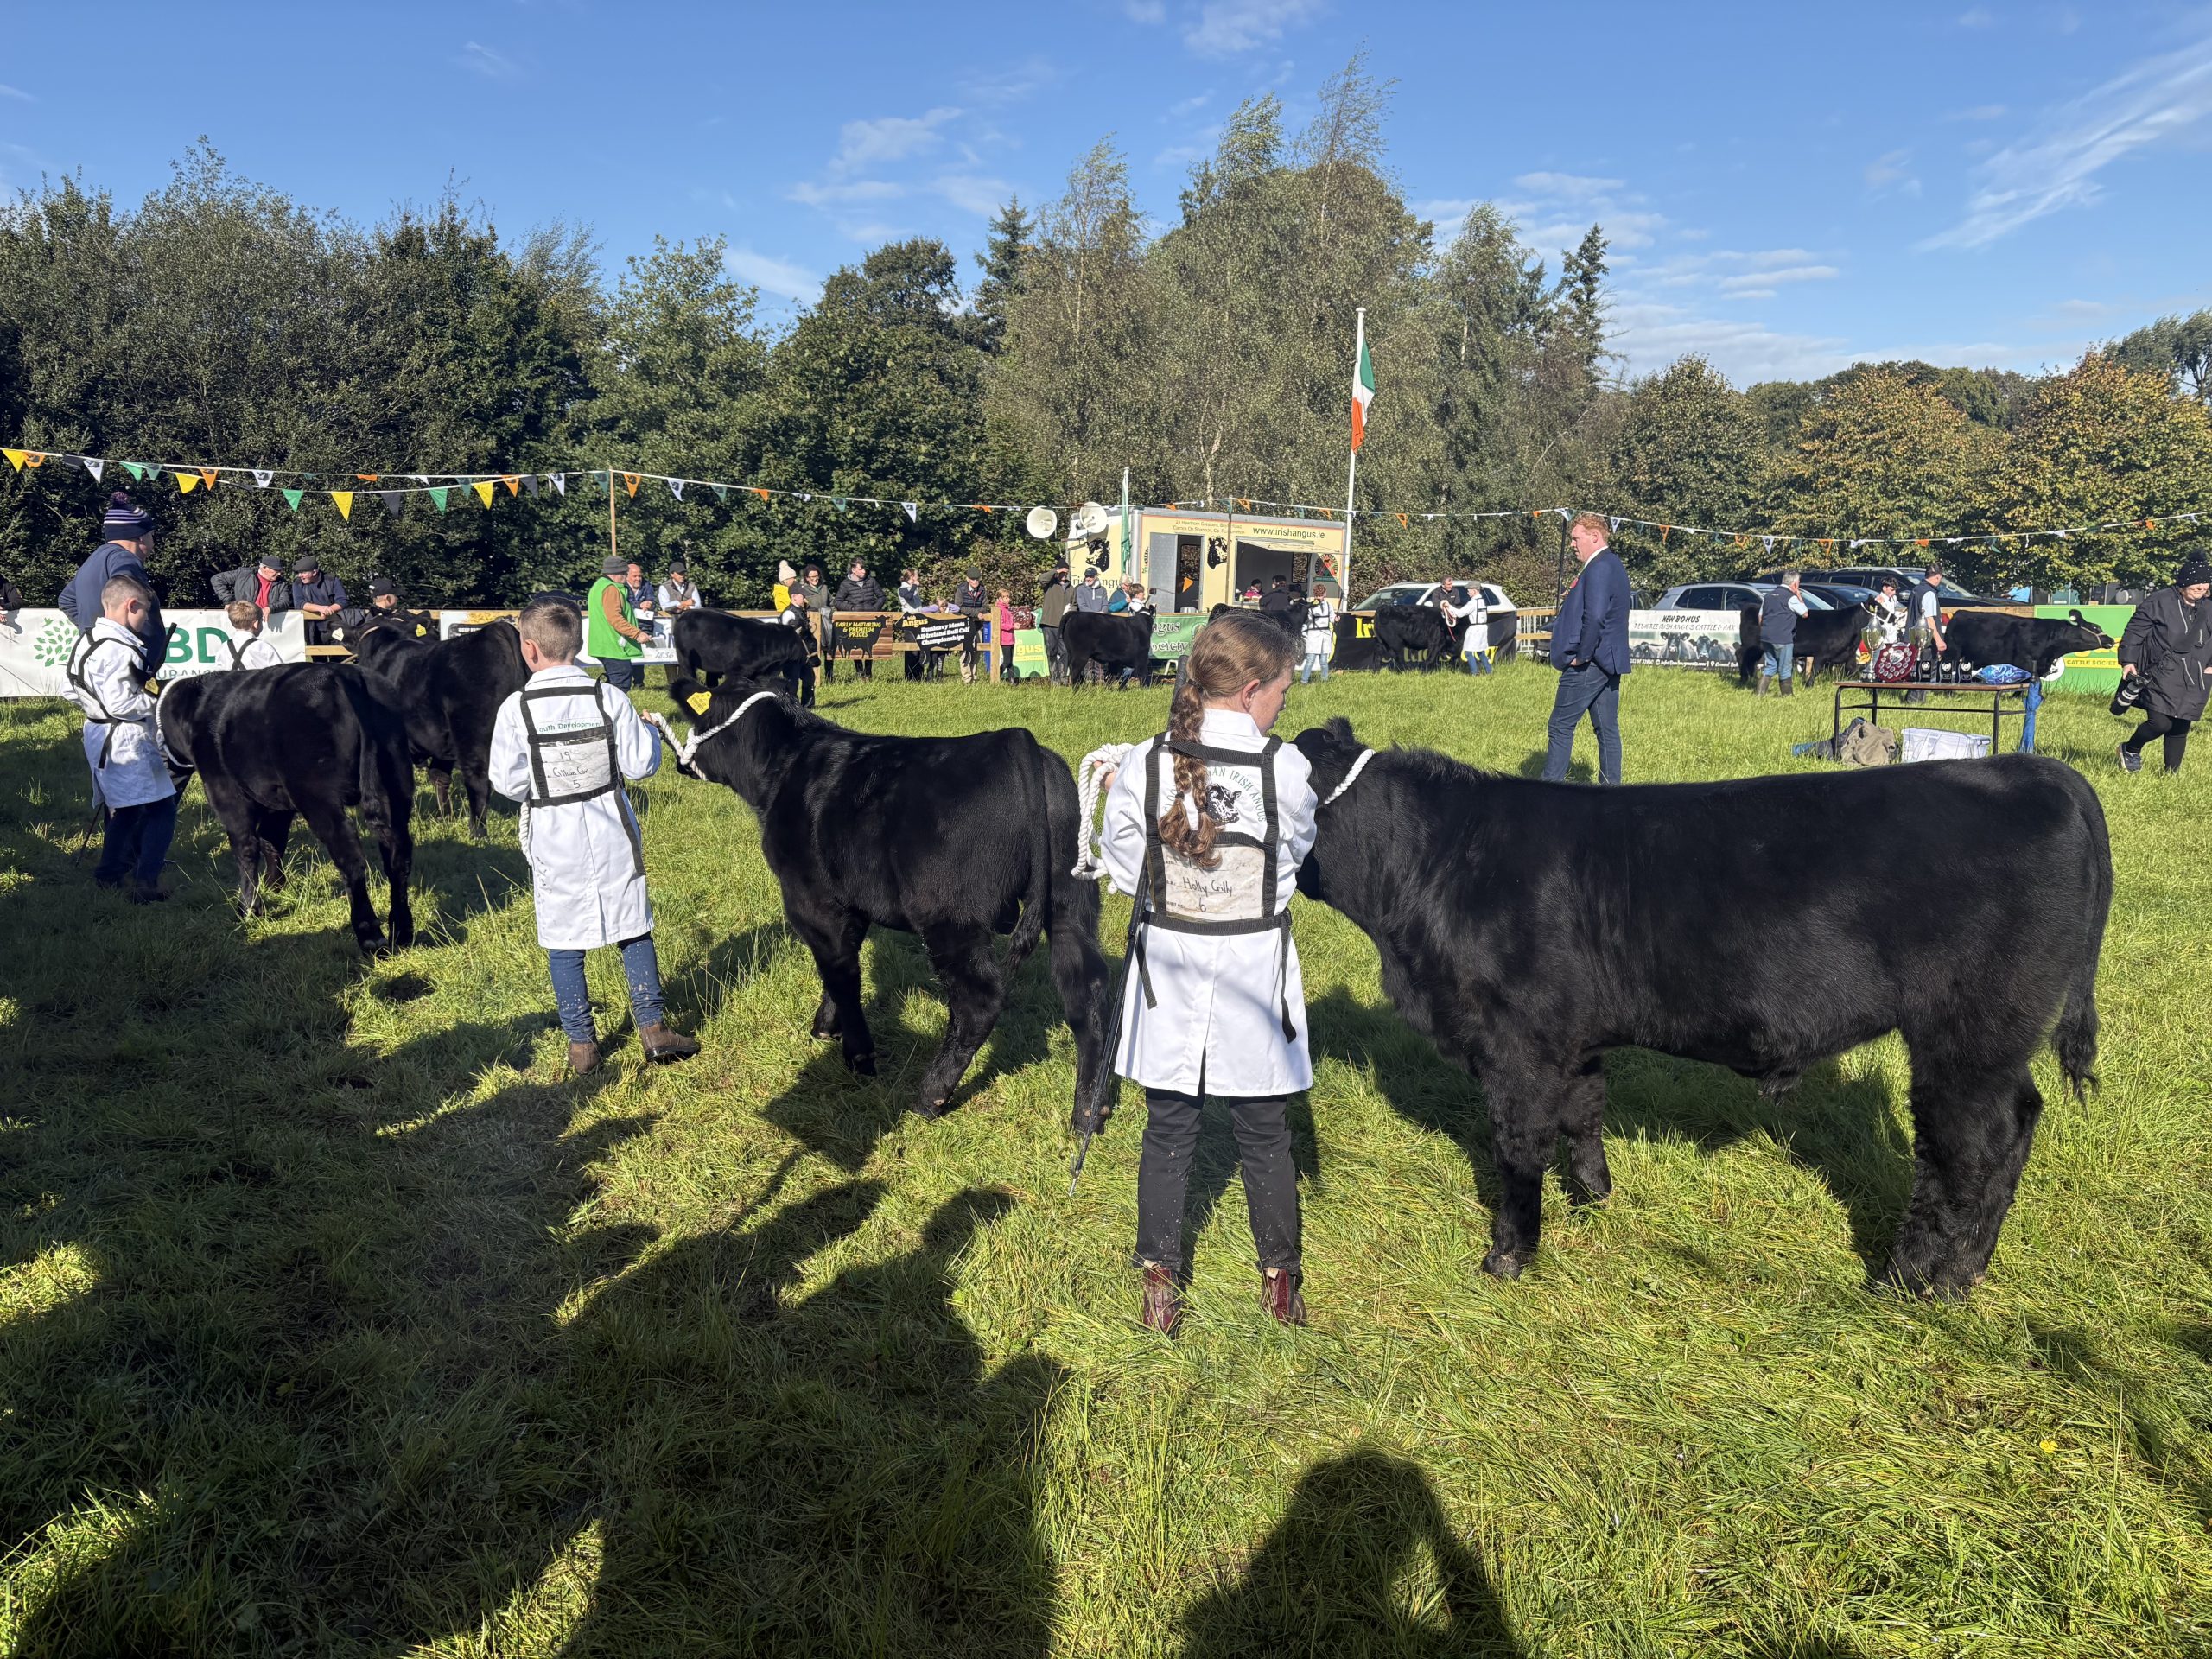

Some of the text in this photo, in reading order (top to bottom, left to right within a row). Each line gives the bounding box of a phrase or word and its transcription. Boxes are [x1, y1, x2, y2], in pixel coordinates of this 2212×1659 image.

[1253, 527, 1325, 539] www.irishangus.ie
[901, 618, 929, 627] Angus
[920, 624, 948, 633] Dunleavy
[916, 631, 946, 640] All-Ireland
[921, 634, 965, 646] Championships
[164, 626, 230, 664] BD
[1016, 644, 1043, 656] gus
[1150, 638, 1189, 656] ociety
[557, 721, 602, 731] Development
[560, 751, 572, 761] 19
[573, 779, 582, 788] 5
[1229, 769, 1254, 791] IRISH
[1182, 876, 1209, 898] Holly
[1198, 897, 1207, 912] 6
